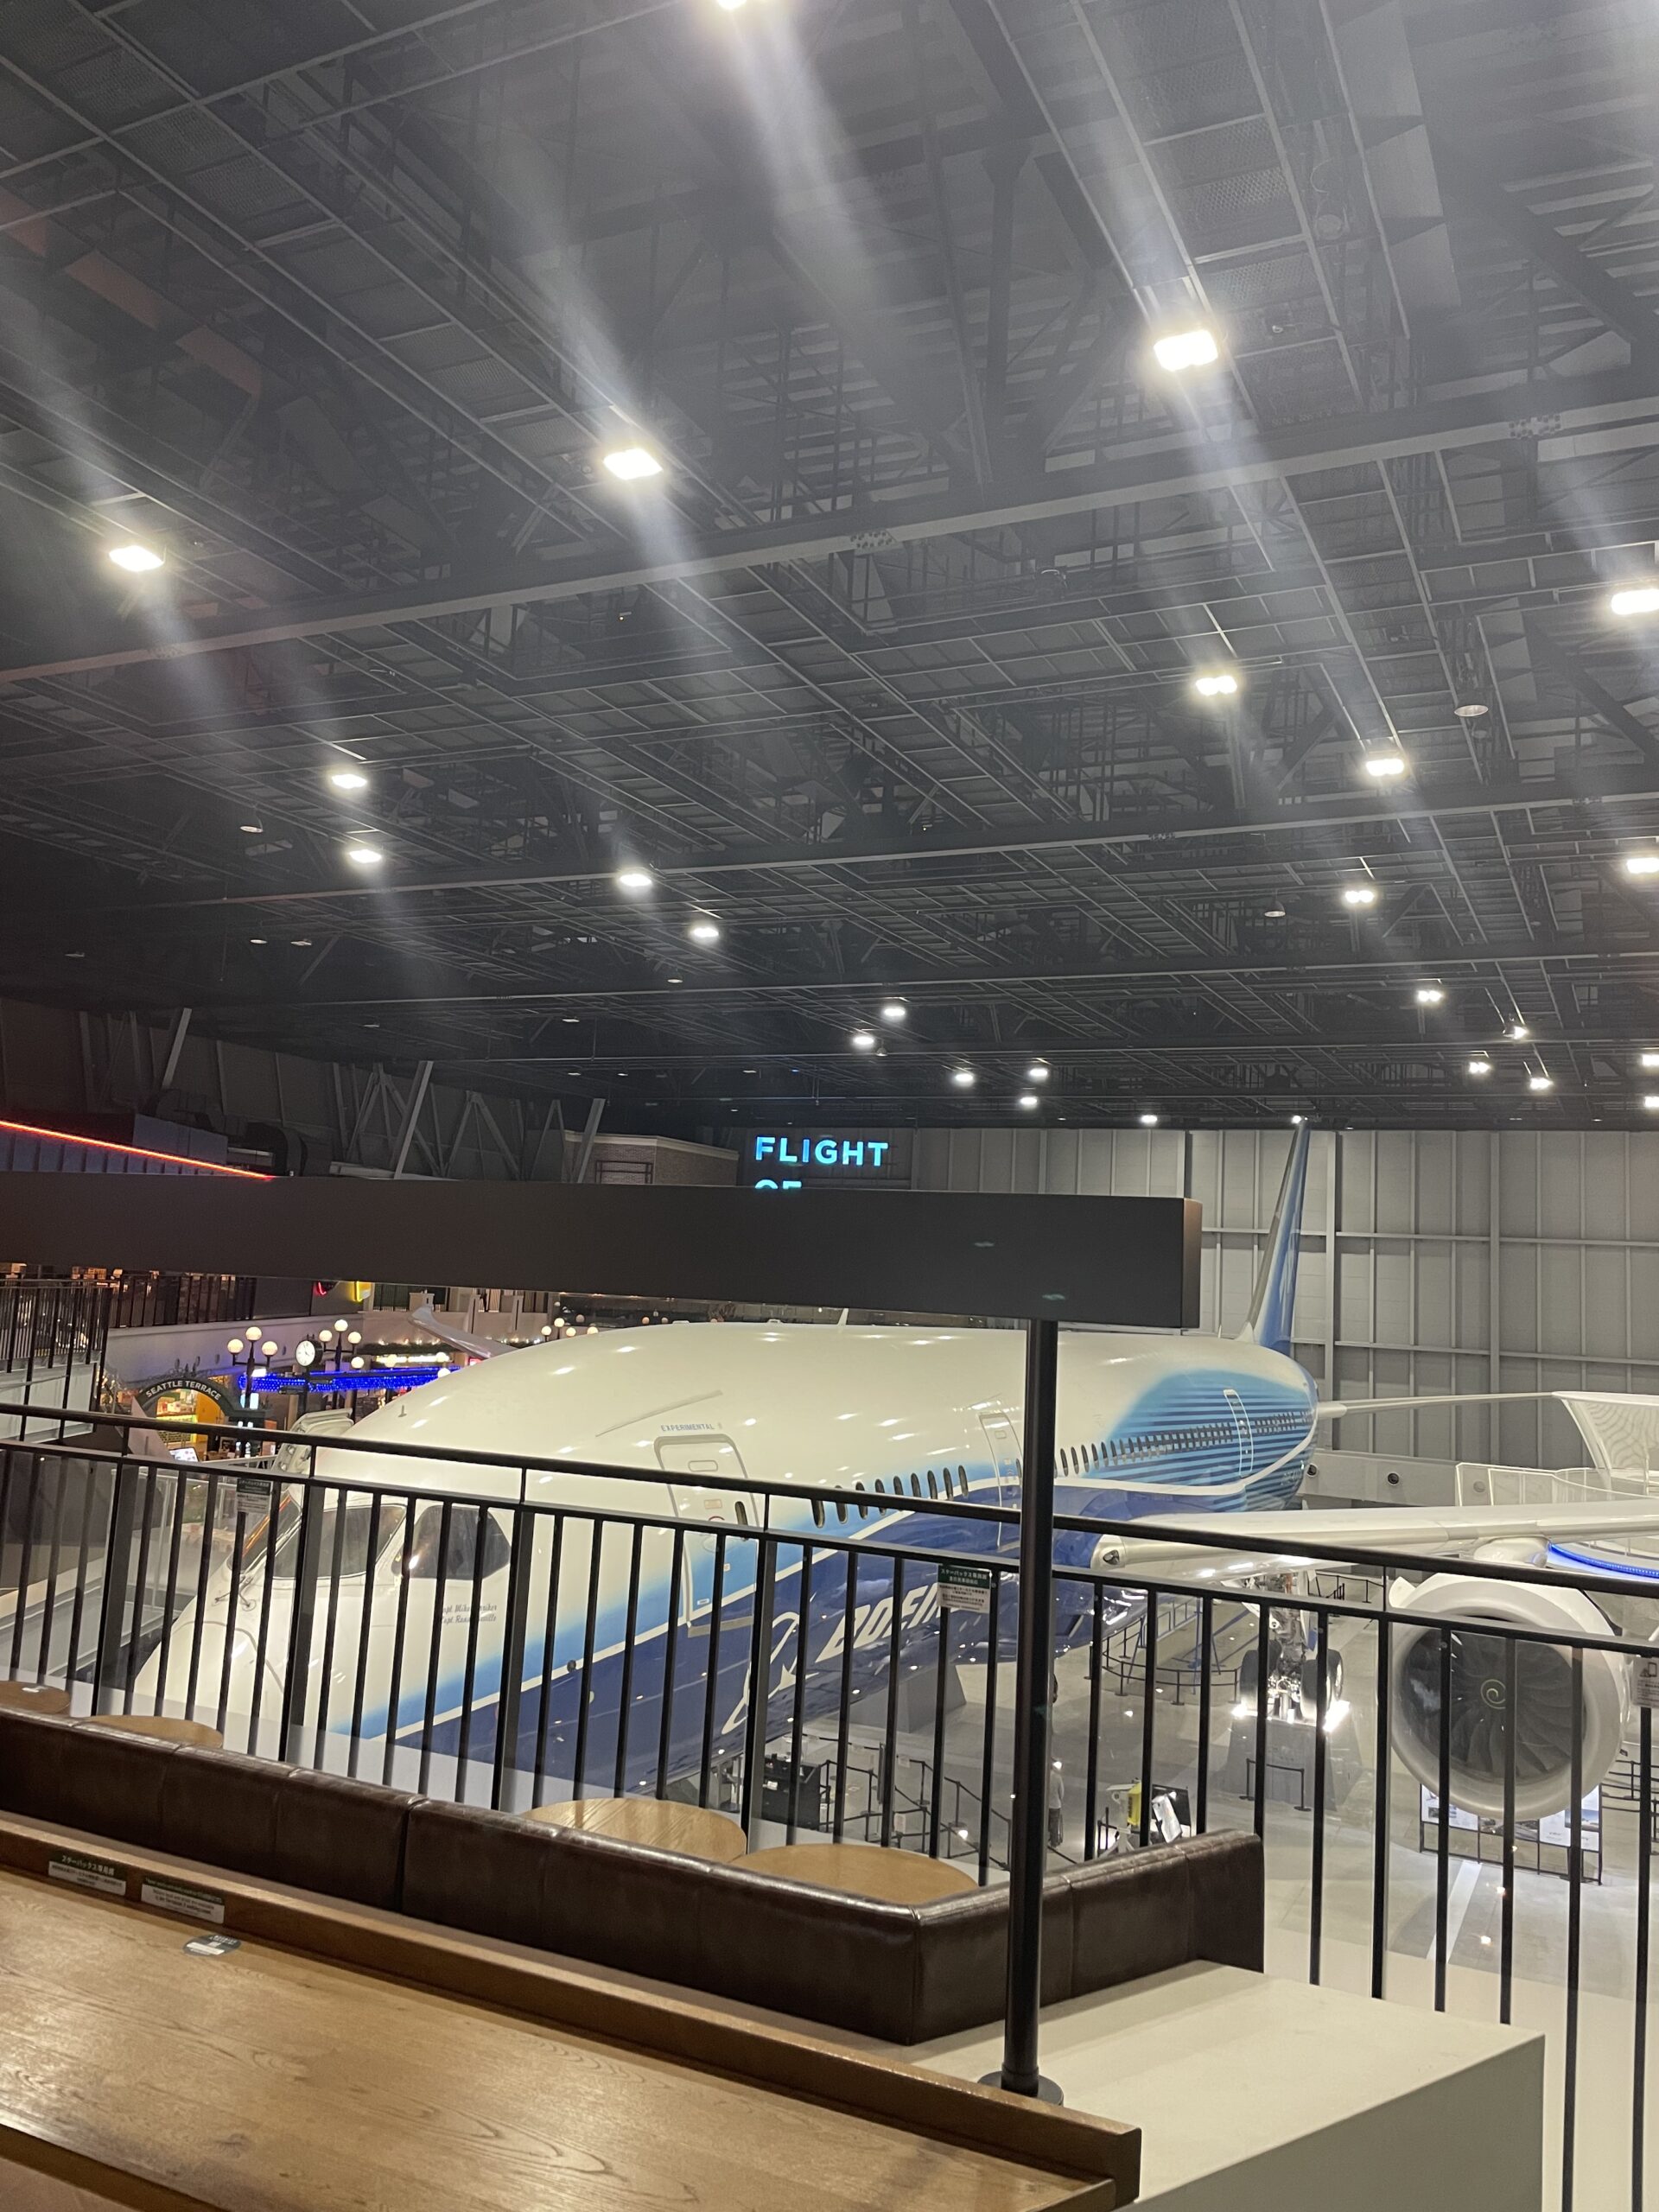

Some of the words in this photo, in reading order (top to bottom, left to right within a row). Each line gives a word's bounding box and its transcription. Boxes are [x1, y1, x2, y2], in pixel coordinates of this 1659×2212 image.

[755, 1136, 888, 1166] FLIGHT
[145, 1380, 183, 1397] SEATTLE
[185, 1380, 222, 1401] TERRACE
[660, 1423, 715, 1432] EXPERIMENTAL
[815, 1582, 954, 1663] BOEI
